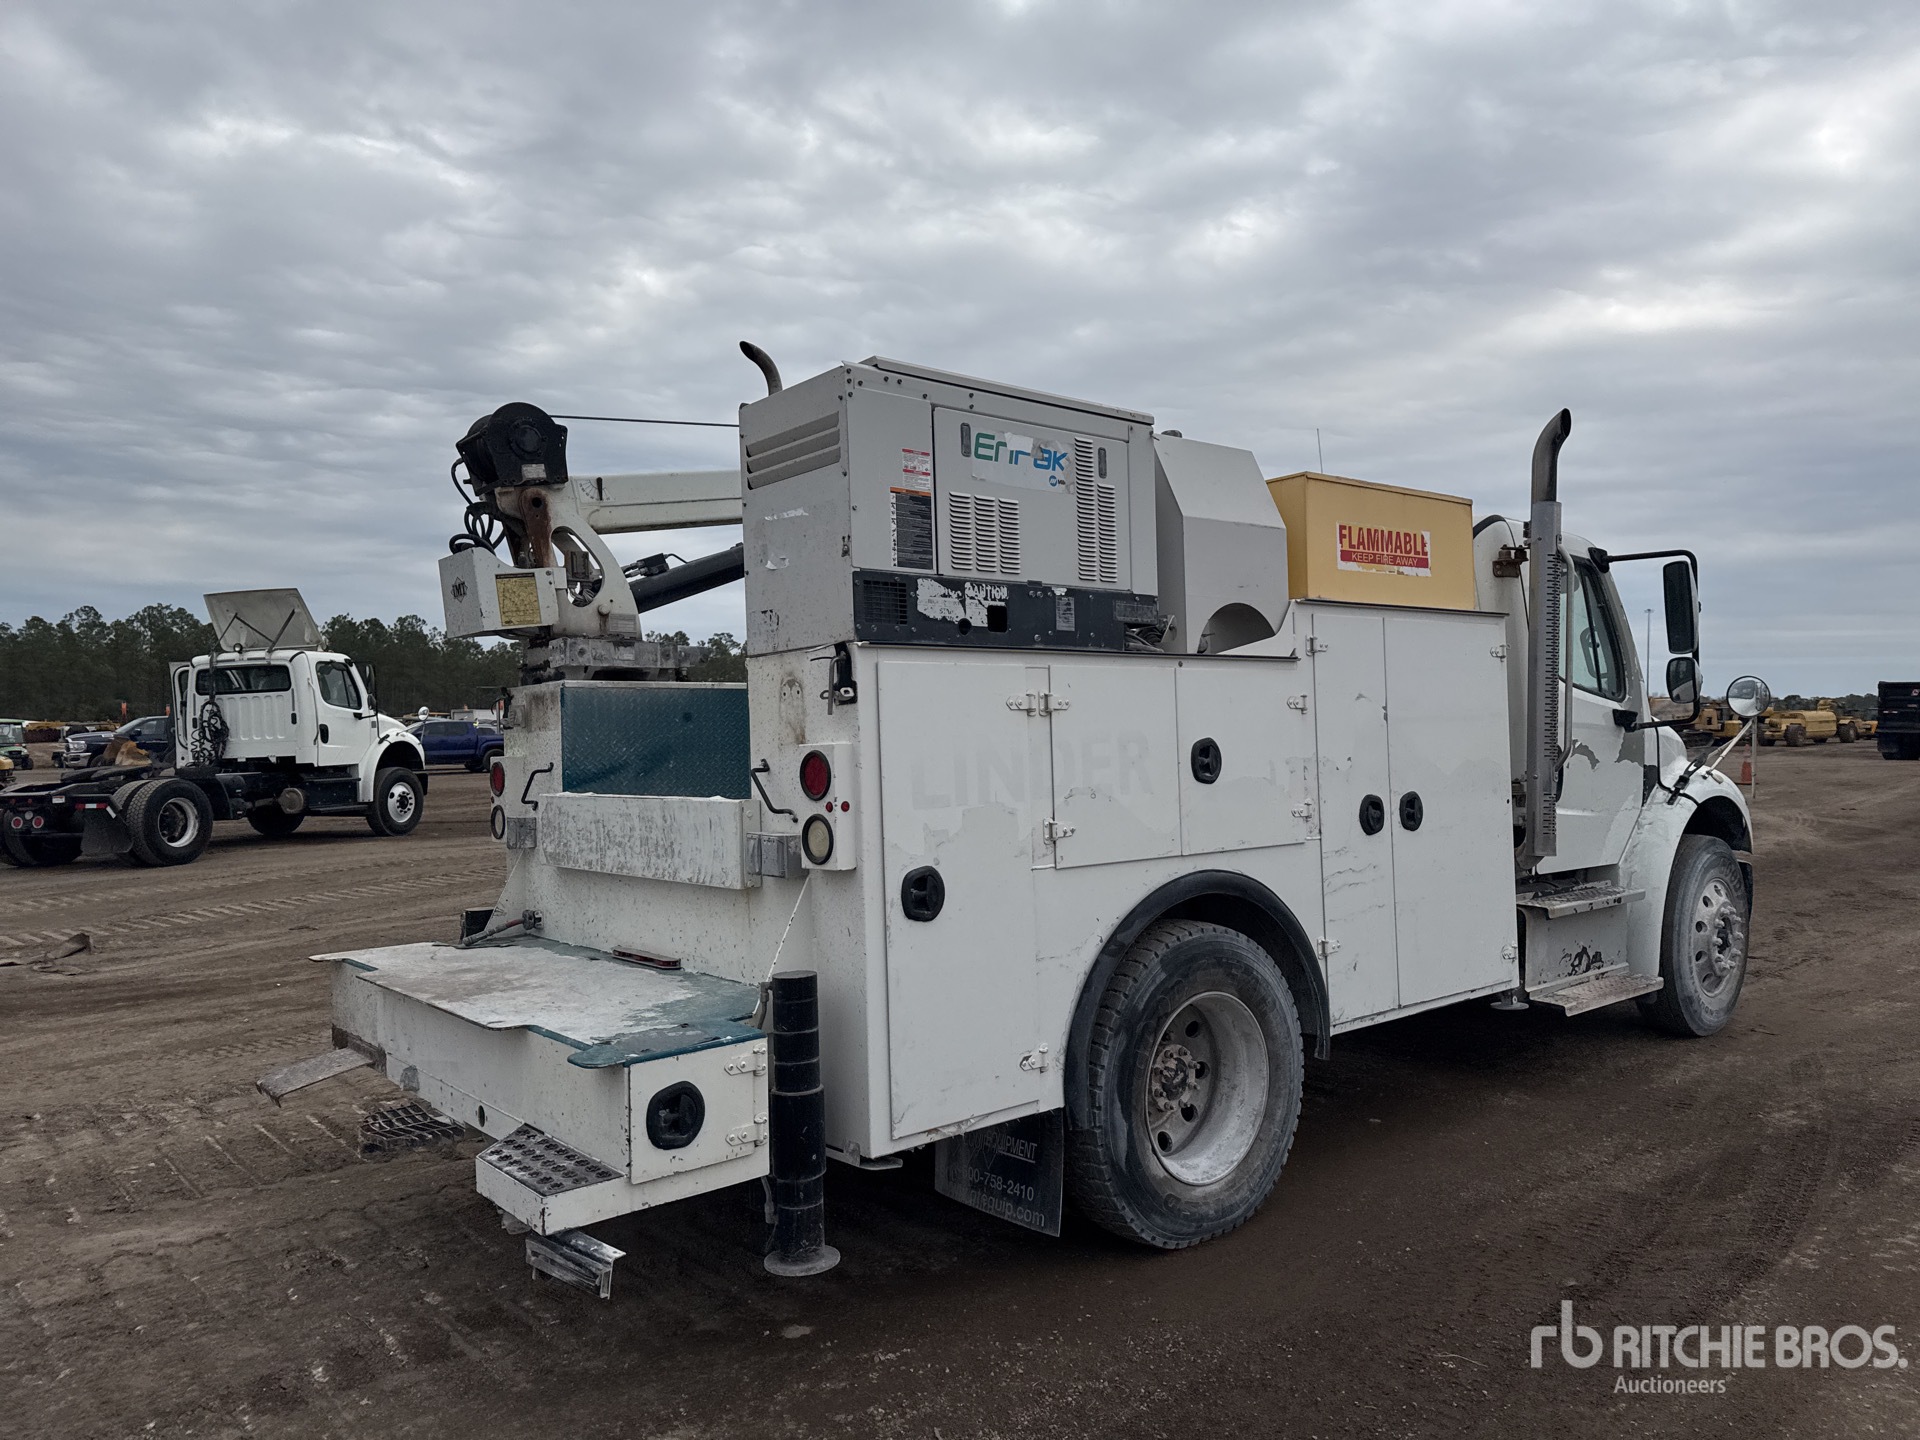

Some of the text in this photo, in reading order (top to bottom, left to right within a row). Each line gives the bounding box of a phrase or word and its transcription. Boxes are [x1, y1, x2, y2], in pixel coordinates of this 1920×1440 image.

[1339, 524, 1428, 556] FLAMMABLE
[1351, 552, 1418, 566] KEEP FIRE AWAY
[965, 582, 1009, 601] CAUTION
[963, 1166, 1035, 1202] 00-758-2410
